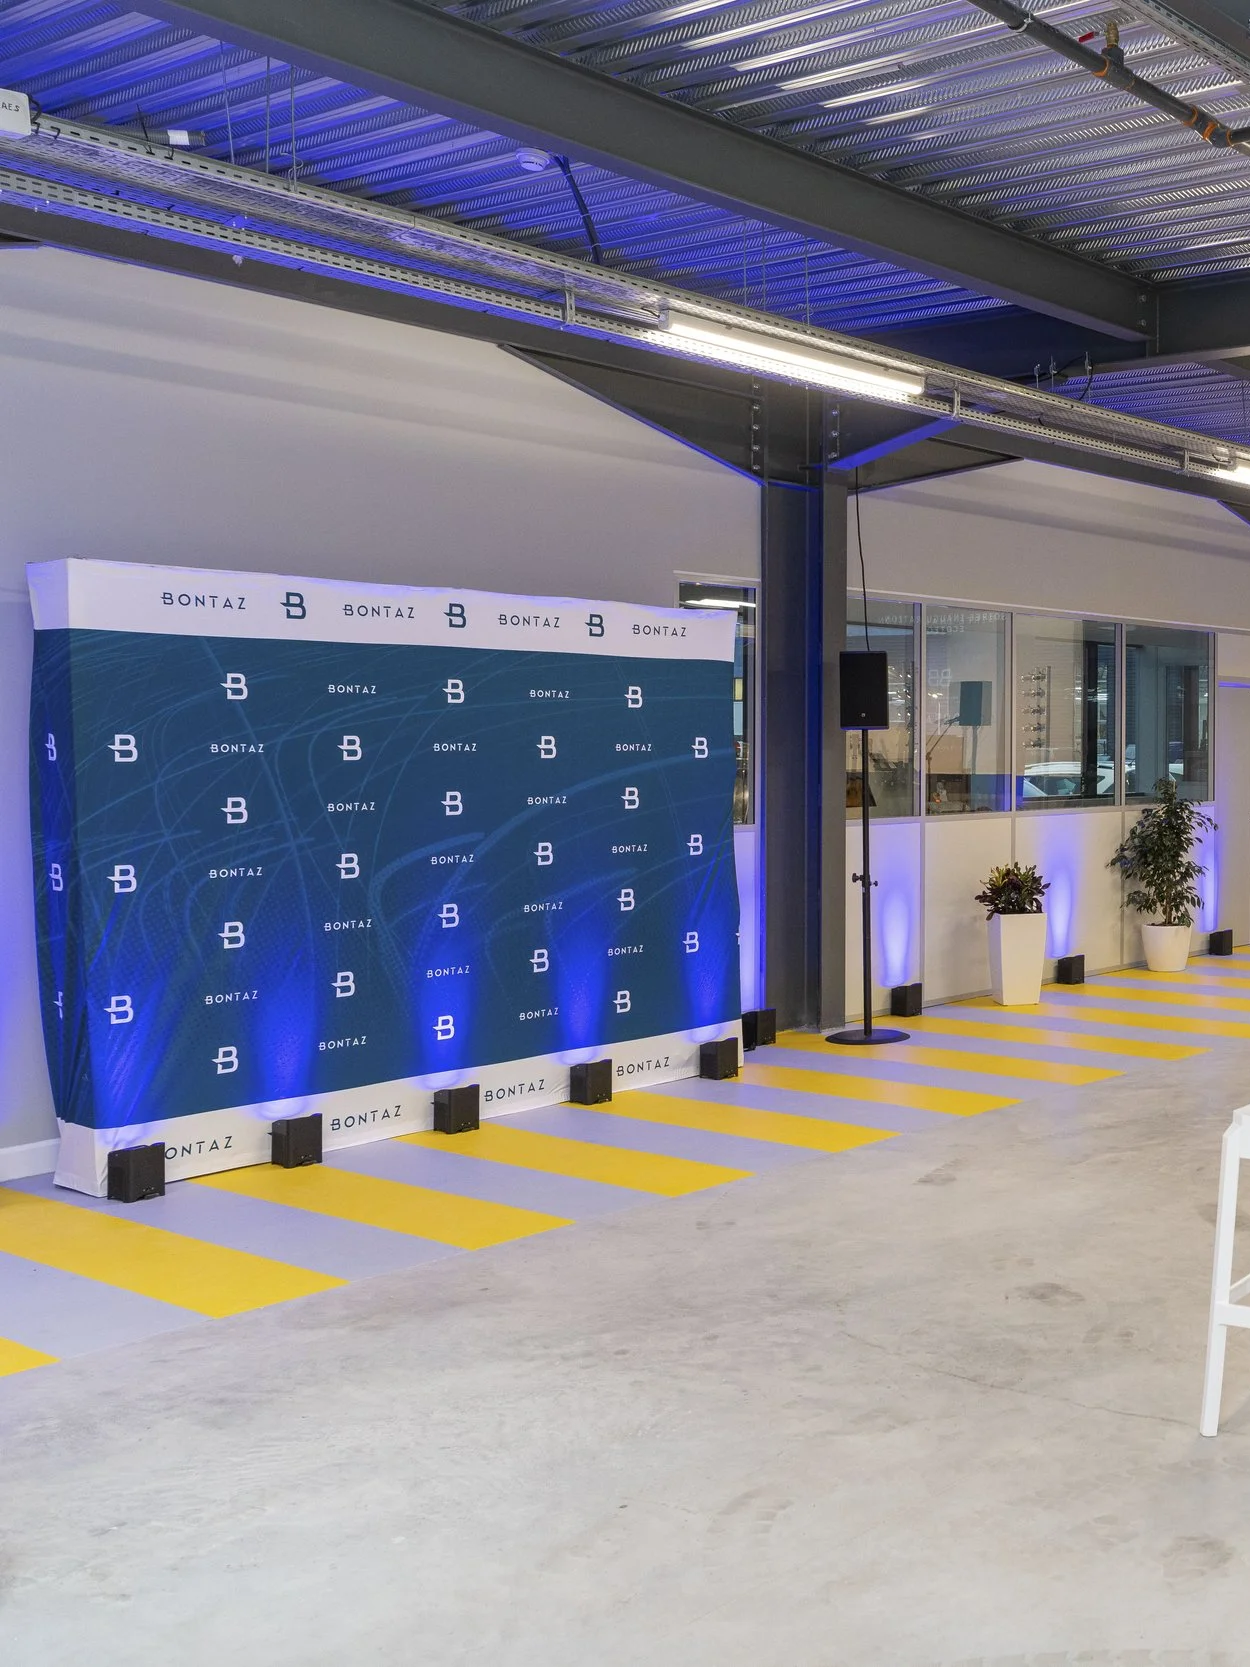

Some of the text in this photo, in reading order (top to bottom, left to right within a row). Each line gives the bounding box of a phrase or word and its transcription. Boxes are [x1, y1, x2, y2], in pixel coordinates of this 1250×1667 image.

[160, 591, 688, 638] BONTAZ B BONTAZ B BONTAZ B BONTAZ
[219, 672, 643, 709] B BONTAZ B BONTAZ B
[107, 733, 709, 763] B BONTAZ B BONTAZ B BONTAZ B
[220, 786, 640, 825] B BONTAZ B BONTAZ B
[106, 833, 704, 894] B BONTAZ B BONTAZ B BONTAZ B
[217, 888, 636, 950] B BONTAZ B BONTAZ B
[103, 930, 700, 1025] B BONTAZ B BONTAZ B BONTAZ B
[211, 989, 632, 1075] B BONTAZ B BONTAZ B
[164, 1056, 671, 1160] ONTAZ BONTAZ BONTAZ BONTAZ
